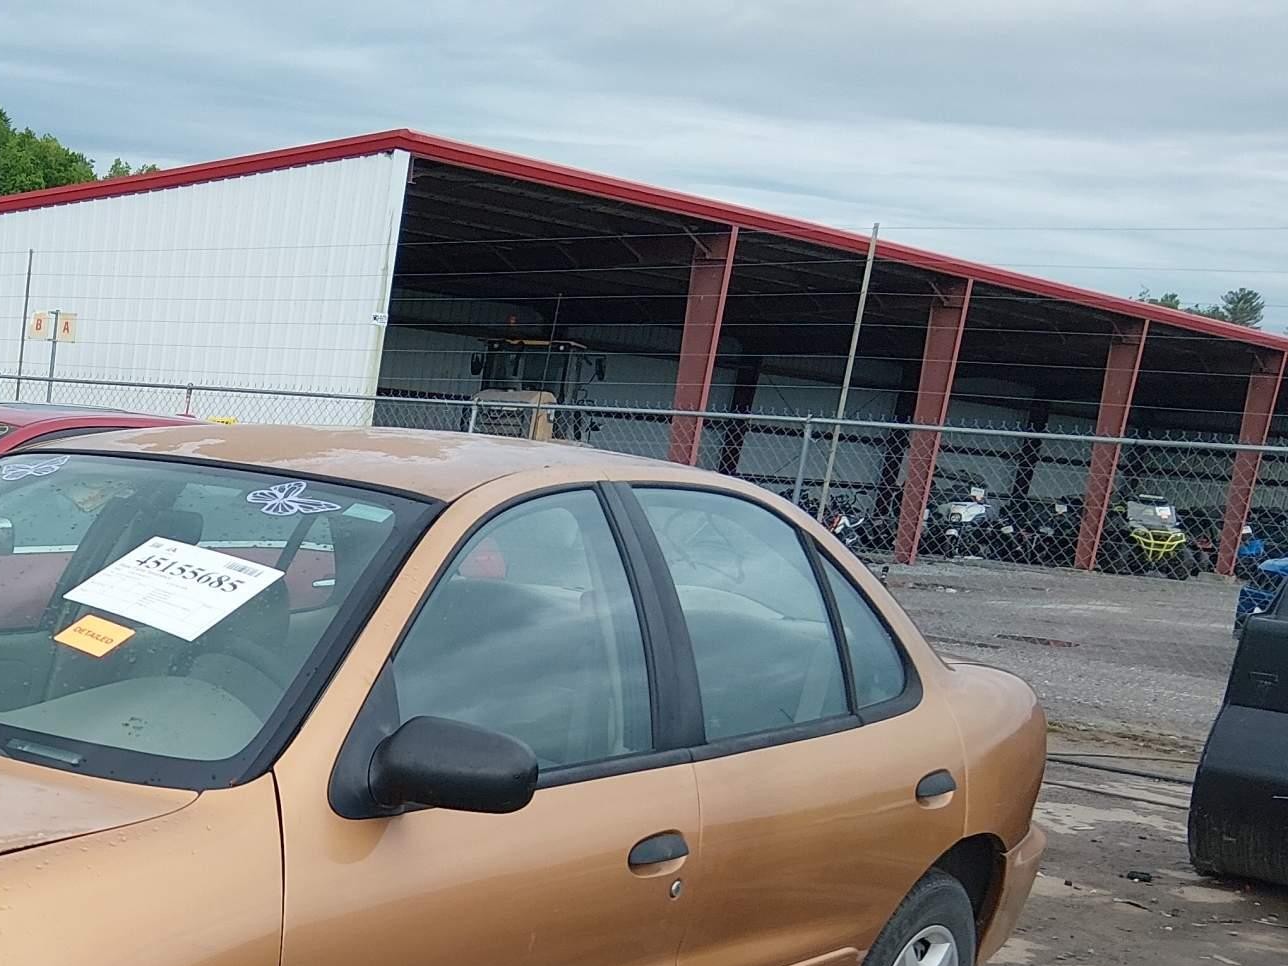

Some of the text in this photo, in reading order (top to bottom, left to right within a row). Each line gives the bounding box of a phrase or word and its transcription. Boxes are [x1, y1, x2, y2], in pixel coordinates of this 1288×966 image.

[35, 318, 43, 330] B
[62, 321, 70, 333] A
[136, 555, 245, 592] 45155685
[73, 626, 114, 645] DETAILED
